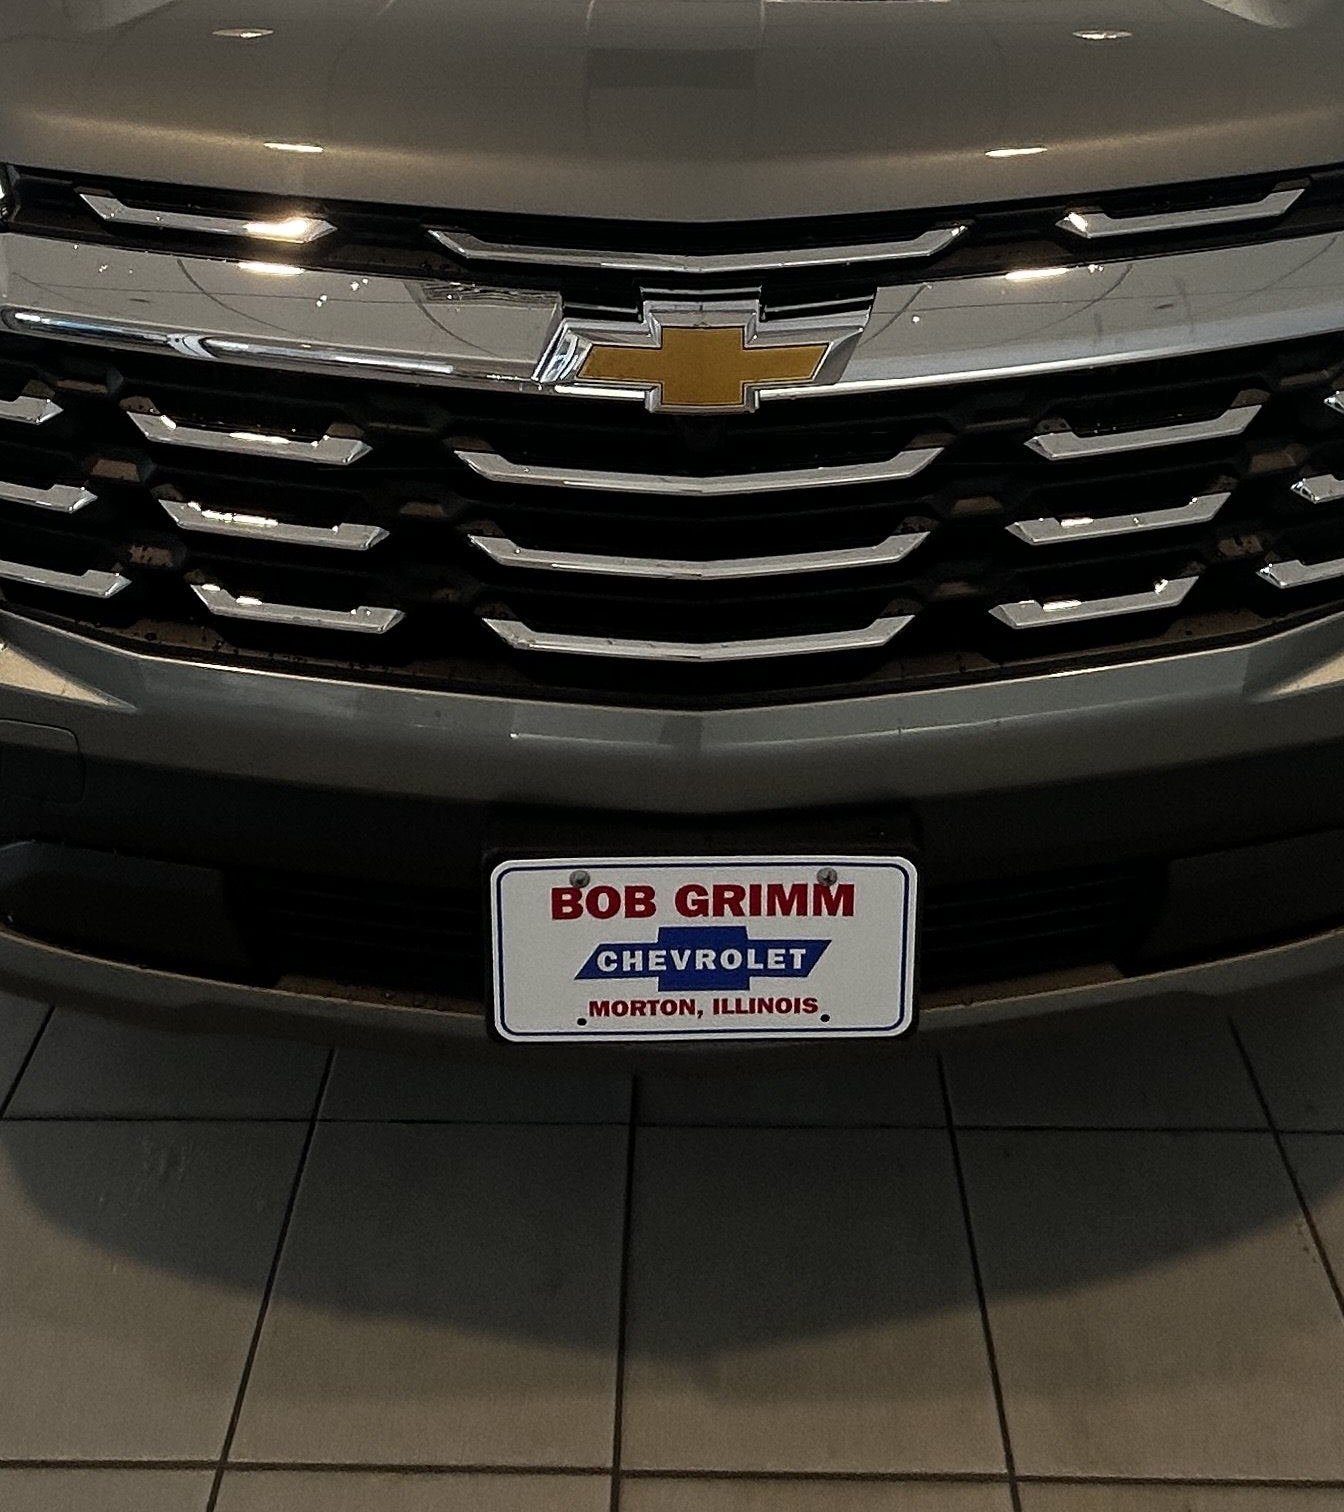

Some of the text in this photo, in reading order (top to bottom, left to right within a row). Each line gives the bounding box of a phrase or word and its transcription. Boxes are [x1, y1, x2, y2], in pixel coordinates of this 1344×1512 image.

[551, 882, 855, 921] BOB GRIMM
[596, 947, 808, 973] CHEVROLET
[588, 996, 819, 1020] MORTON, ILLINOIS
